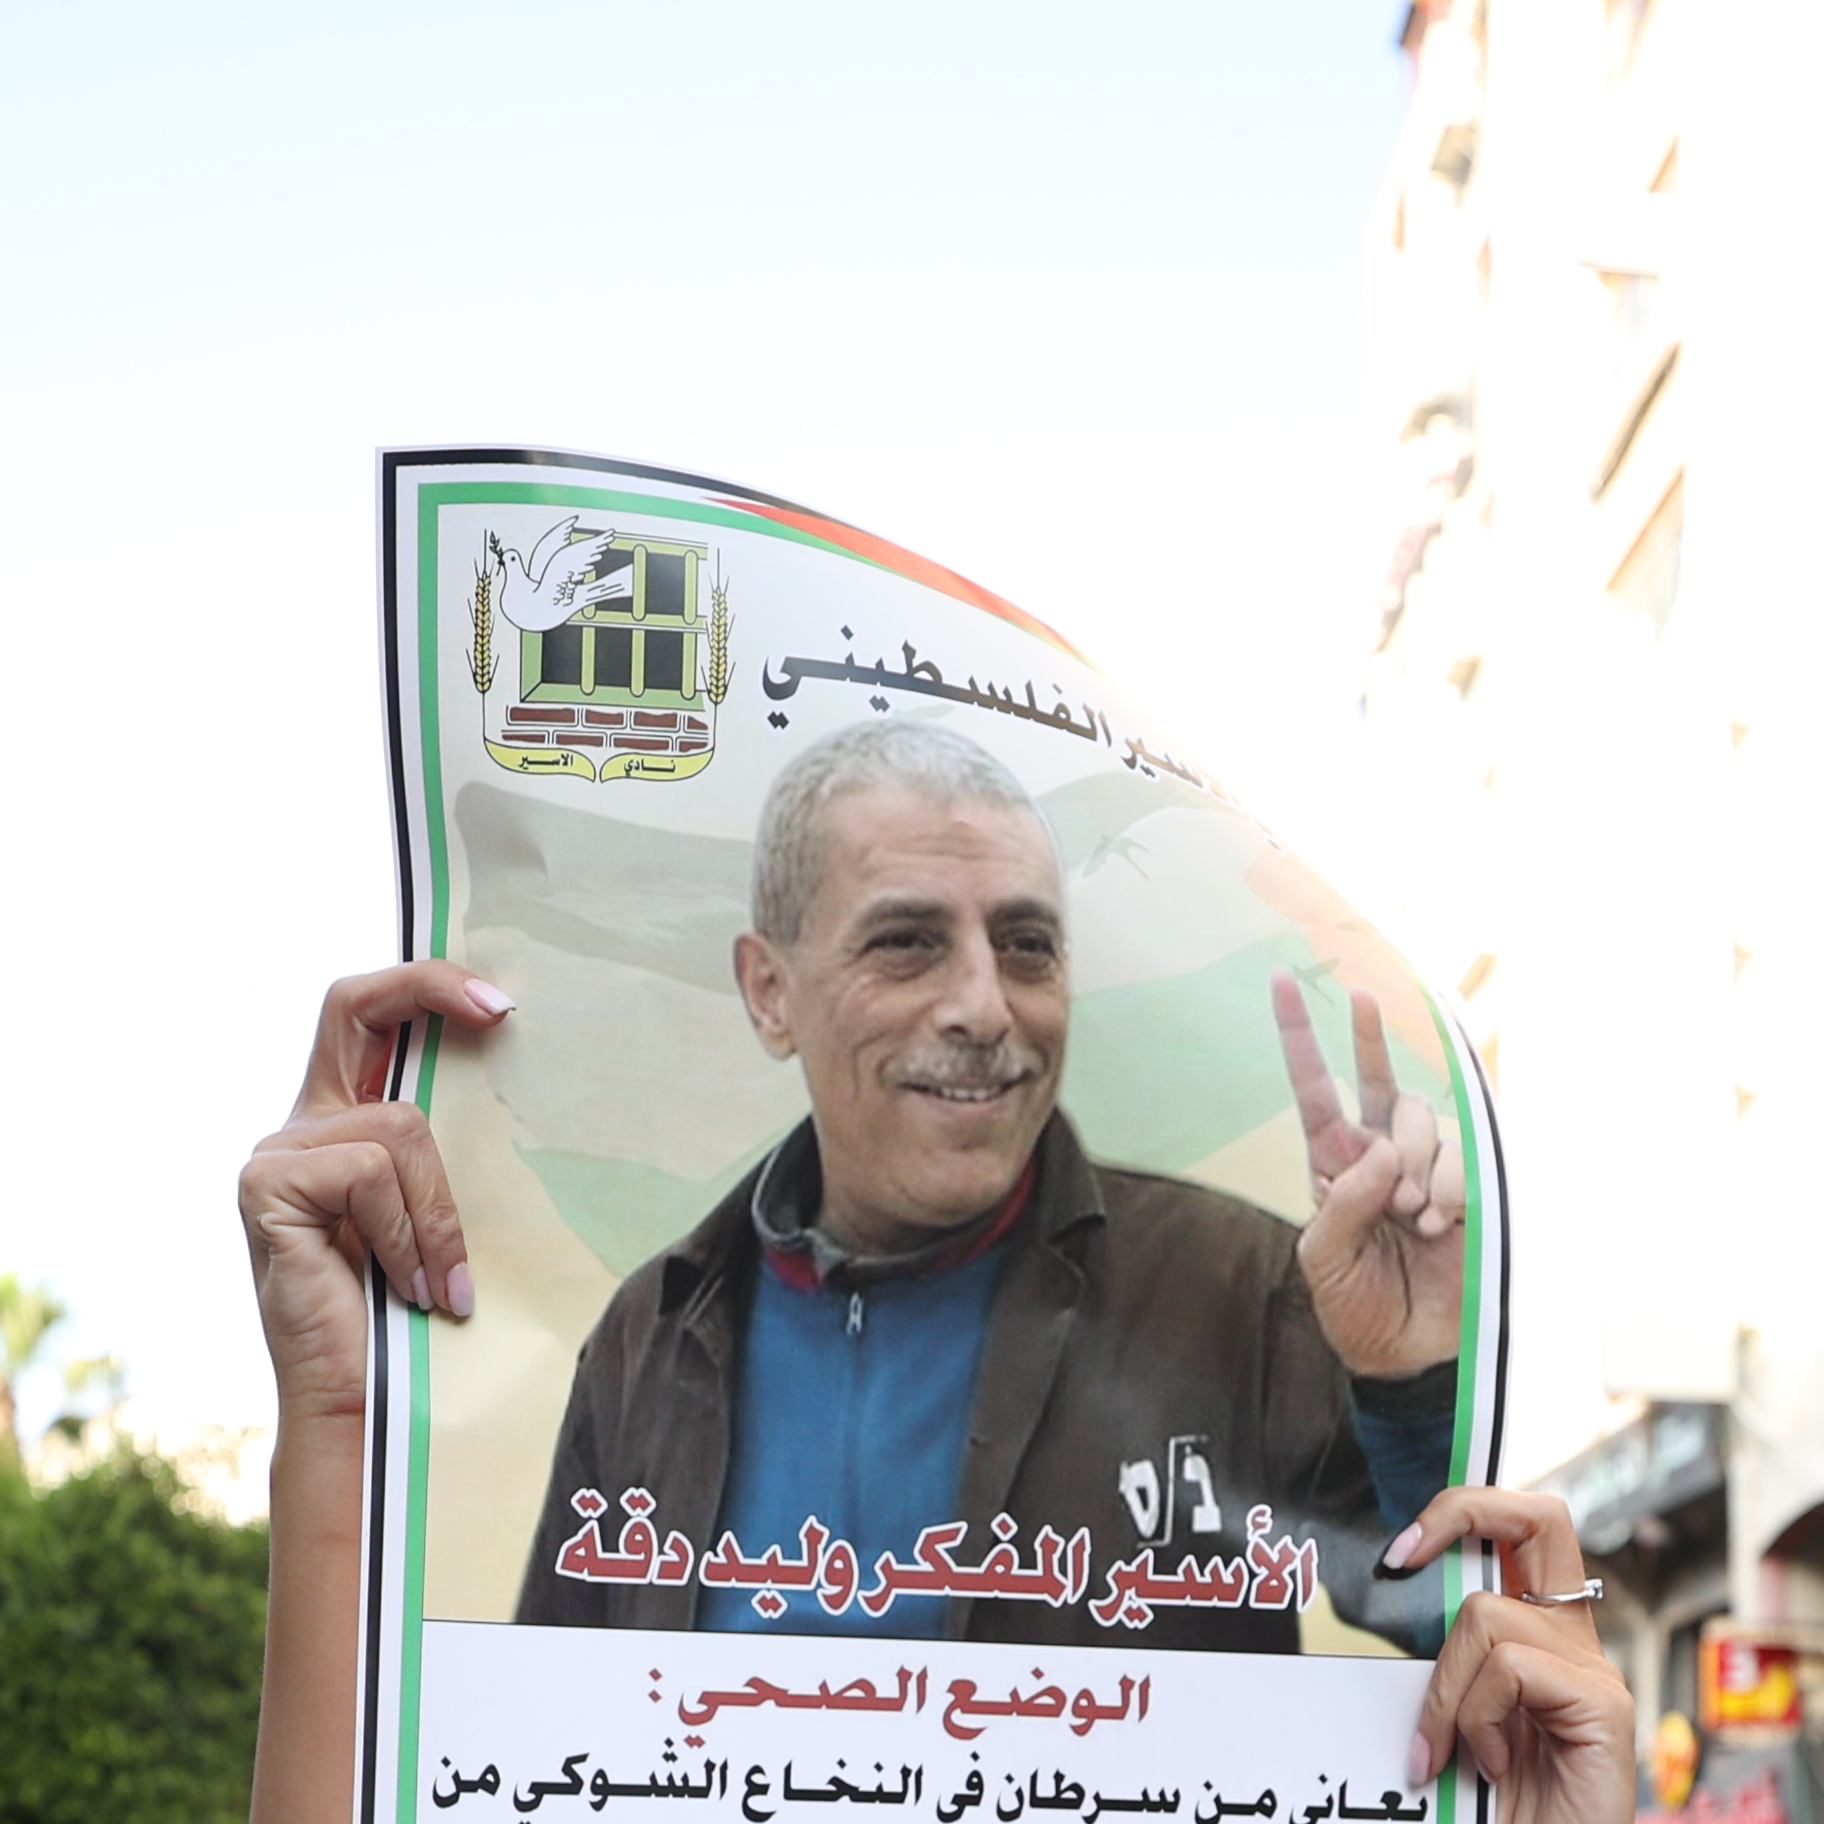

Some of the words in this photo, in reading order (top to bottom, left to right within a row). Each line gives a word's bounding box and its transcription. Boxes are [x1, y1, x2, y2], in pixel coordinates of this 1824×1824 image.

[762, 624, 1113, 748] الفلسطيني
[623, 758, 677, 777] نادي
[556, 1486, 693, 1587] دقة
[699, 1515, 858, 1619] وليد
[858, 1512, 1090, 1619] المفكر
[1089, 1503, 1319, 1629] الأسير
[942, 1667, 1152, 1739] الوضع
[433, 1756, 501, 1808] من
[742, 1759, 923, 1822] النخاع
[996, 1768, 1180, 1824] سرطان
